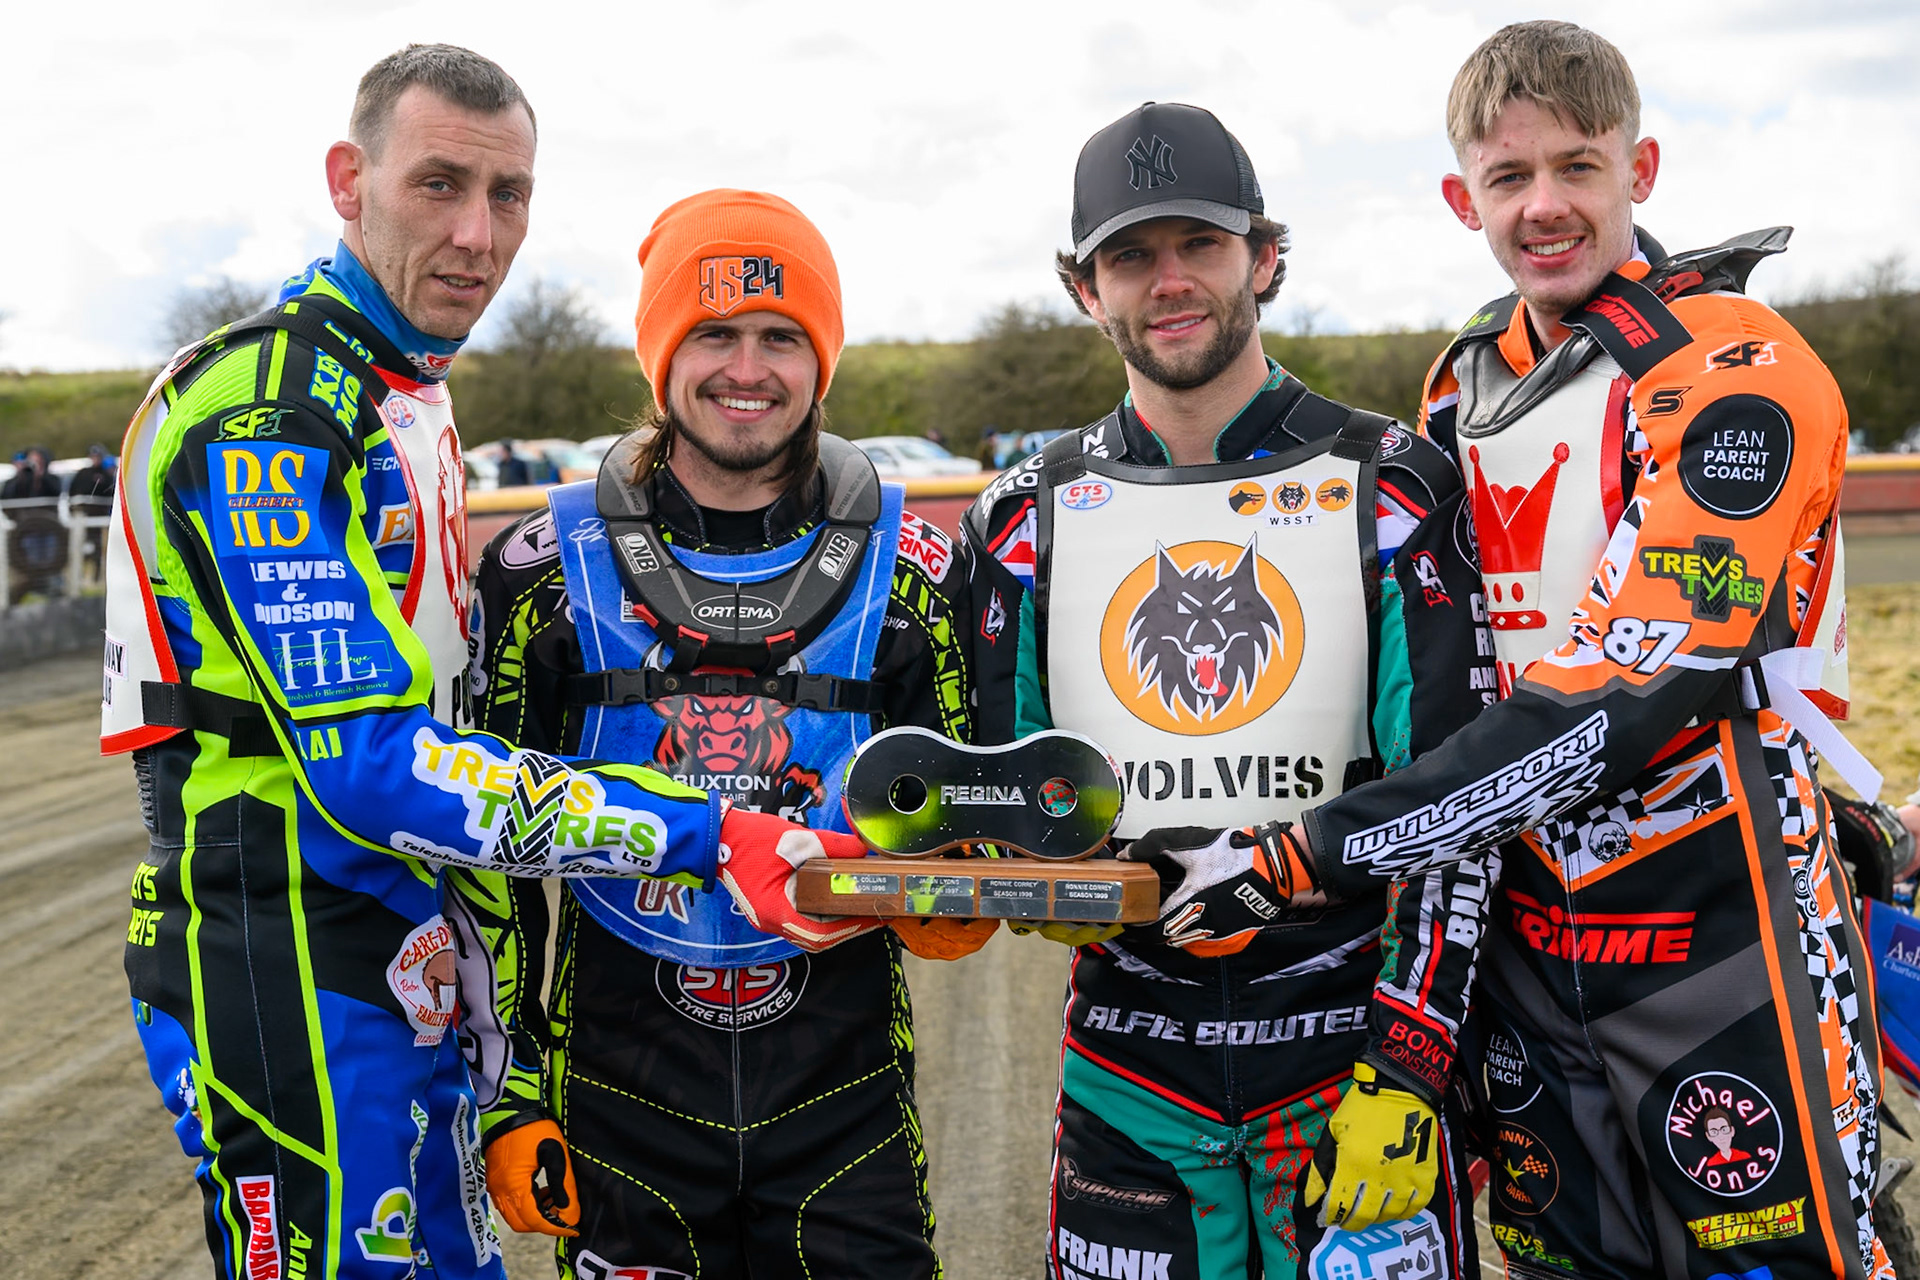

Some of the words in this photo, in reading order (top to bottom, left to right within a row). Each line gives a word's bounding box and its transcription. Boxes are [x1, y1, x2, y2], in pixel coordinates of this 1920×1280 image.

[1125, 134, 1178, 191] NY
[1713, 430, 1765, 448] LEAN
[1703, 450, 1769, 466] PARENT
[1703, 465, 1765, 482] COACH
[228, 496, 304, 508] GILBERT
[1644, 552, 1744, 580] TREVS
[281, 583, 307, 602] &
[1681, 574, 1764, 605] TYRES
[697, 605, 775, 620] ORTEMA
[1603, 617, 1692, 676] 87
[323, 687, 354, 696] Blemish
[355, 681, 389, 692] Removal
[422, 740, 595, 815] TREVS
[1347, 718, 1606, 858] WULFSPORT
[940, 785, 1027, 806] REGINA
[476, 788, 658, 855] TYRES
[621, 851, 652, 868] LTD
[675, 997, 715, 1021] TYRE
[718, 987, 794, 1025] SERVICES
[1083, 1005, 1186, 1042] ALFIE
[1388, 1021, 1454, 1073] BOWT
[1670, 1079, 1771, 1138] Michael
[463, 1160, 477, 1204] 01778
[1687, 1145, 1777, 1191] Jones
[1071, 1176, 1172, 1206] SUPREME
[1058, 1226, 1173, 1280] FRANK
[1490, 1224, 1545, 1252] REVS
